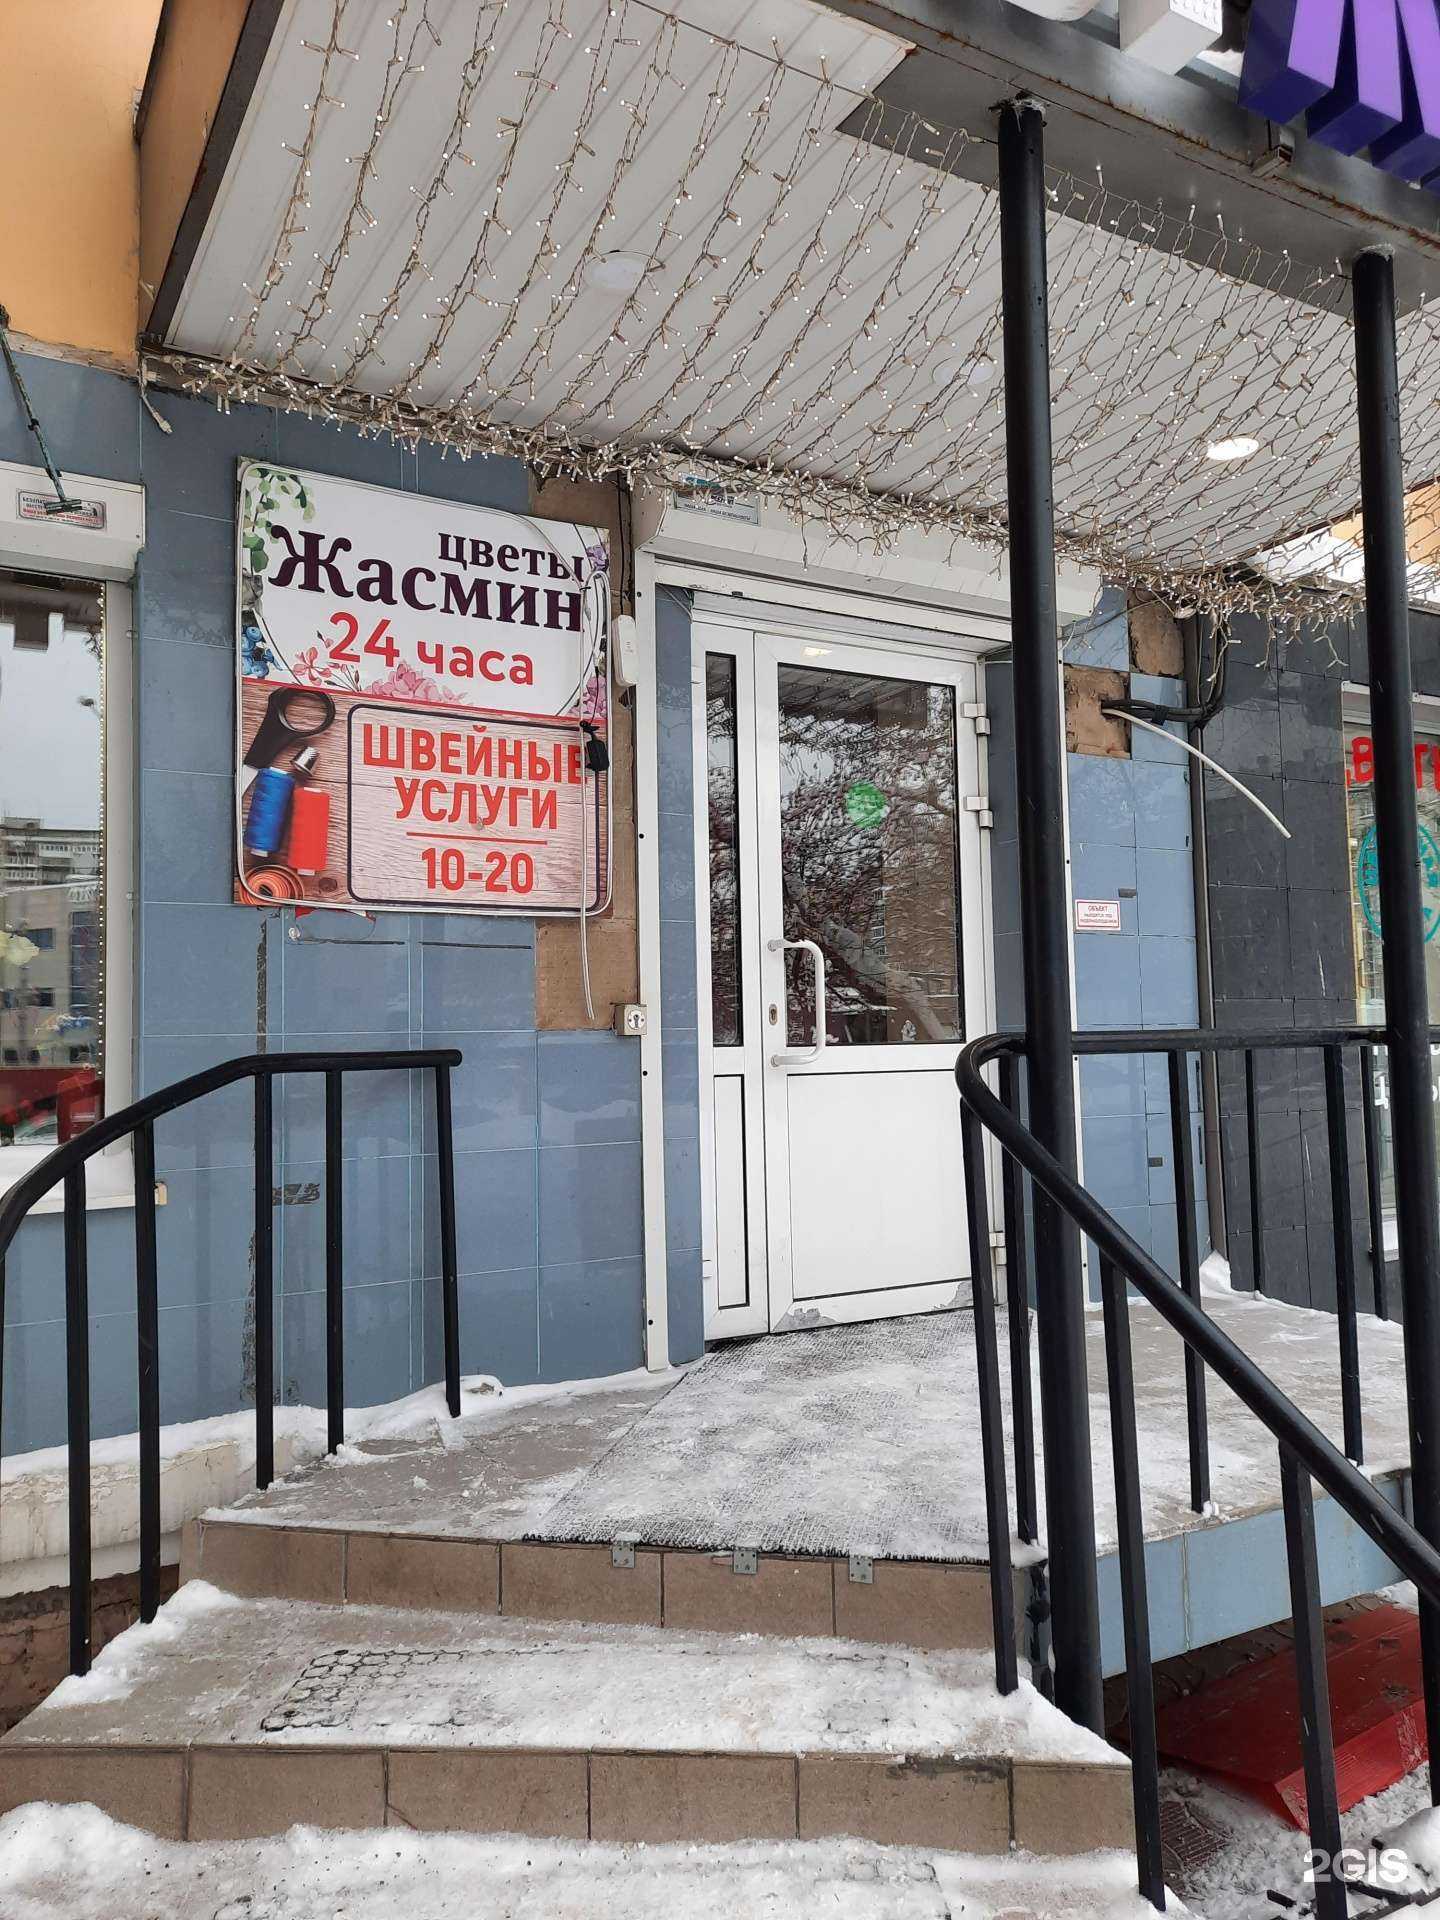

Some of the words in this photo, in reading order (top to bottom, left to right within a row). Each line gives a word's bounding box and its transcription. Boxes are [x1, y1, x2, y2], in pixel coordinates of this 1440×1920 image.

[268, 525, 585, 633] Жасмин
[438, 532, 585, 582] цветы
[328, 612, 401, 668] 24
[416, 640, 535, 686] часа
[363, 723, 588, 785] ШВЕЙНЫЕ
[394, 777, 558, 830] УСЛУГИ
[421, 847, 535, 895] 10-20
